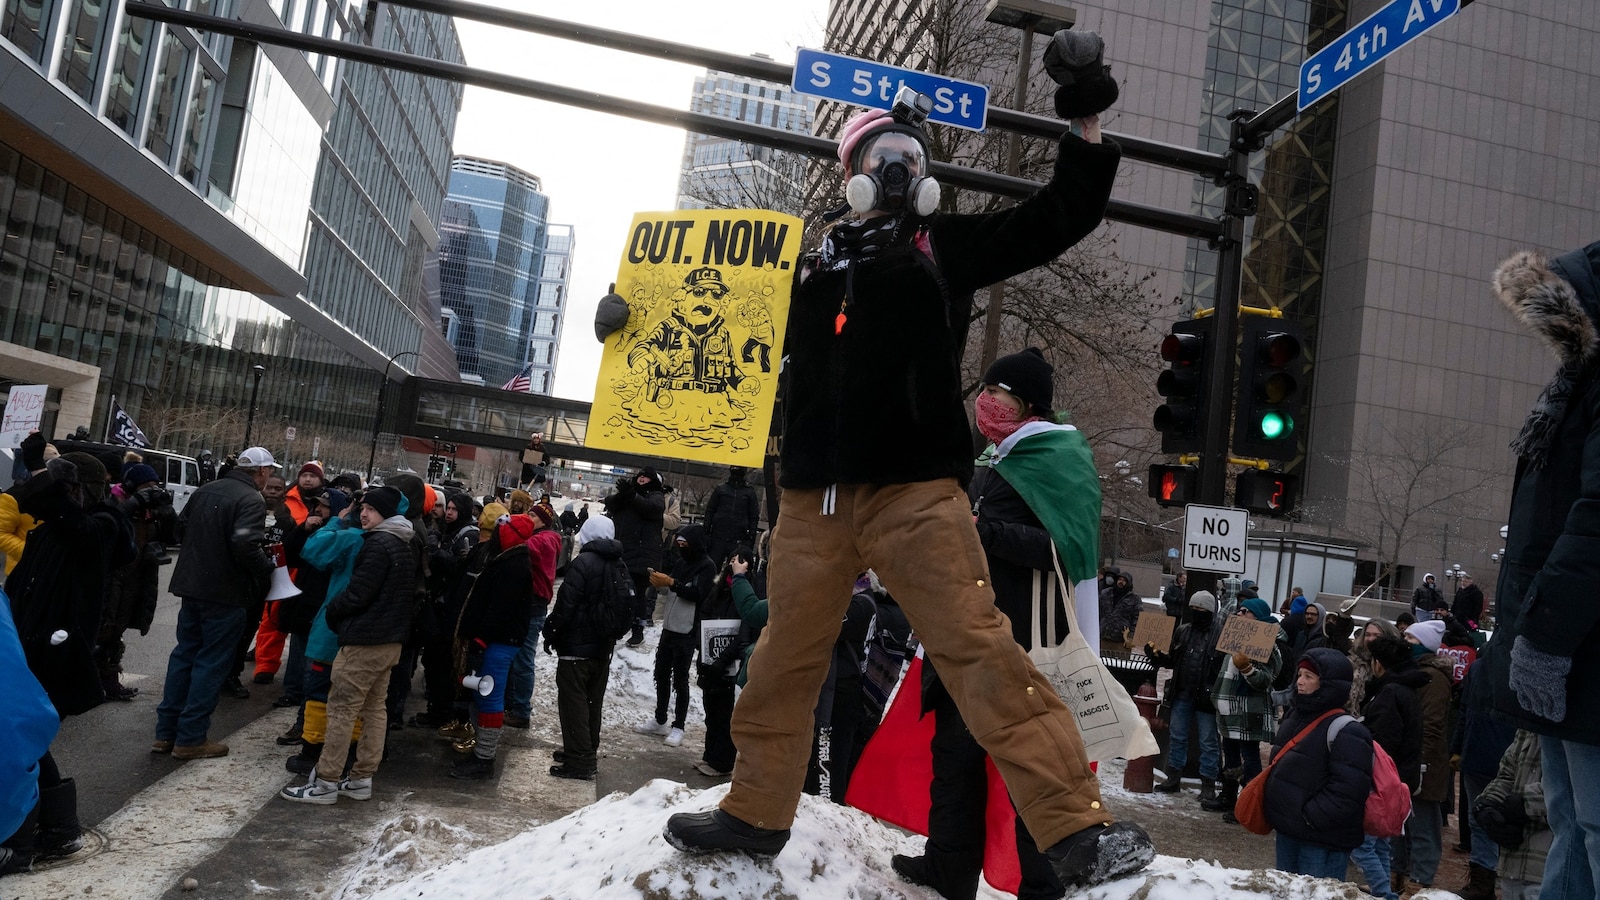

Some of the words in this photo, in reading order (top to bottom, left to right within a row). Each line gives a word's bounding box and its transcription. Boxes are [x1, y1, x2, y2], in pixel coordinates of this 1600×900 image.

[1306, 63, 1322, 95] S
[1334, 23, 1388, 73] 4th
[809, 61, 832, 88] S
[934, 87, 973, 119] St
[628, 220, 695, 265] OUT.
[702, 219, 790, 270] NOW.
[695, 269, 719, 281] I.C.E.
[1202, 517, 1230, 537] NO
[1188, 543, 1241, 563] TURNS
[1076, 678, 1093, 689] FUCK
[1083, 692, 1095, 702] OFF
[1079, 703, 1110, 718] FASCISTS
